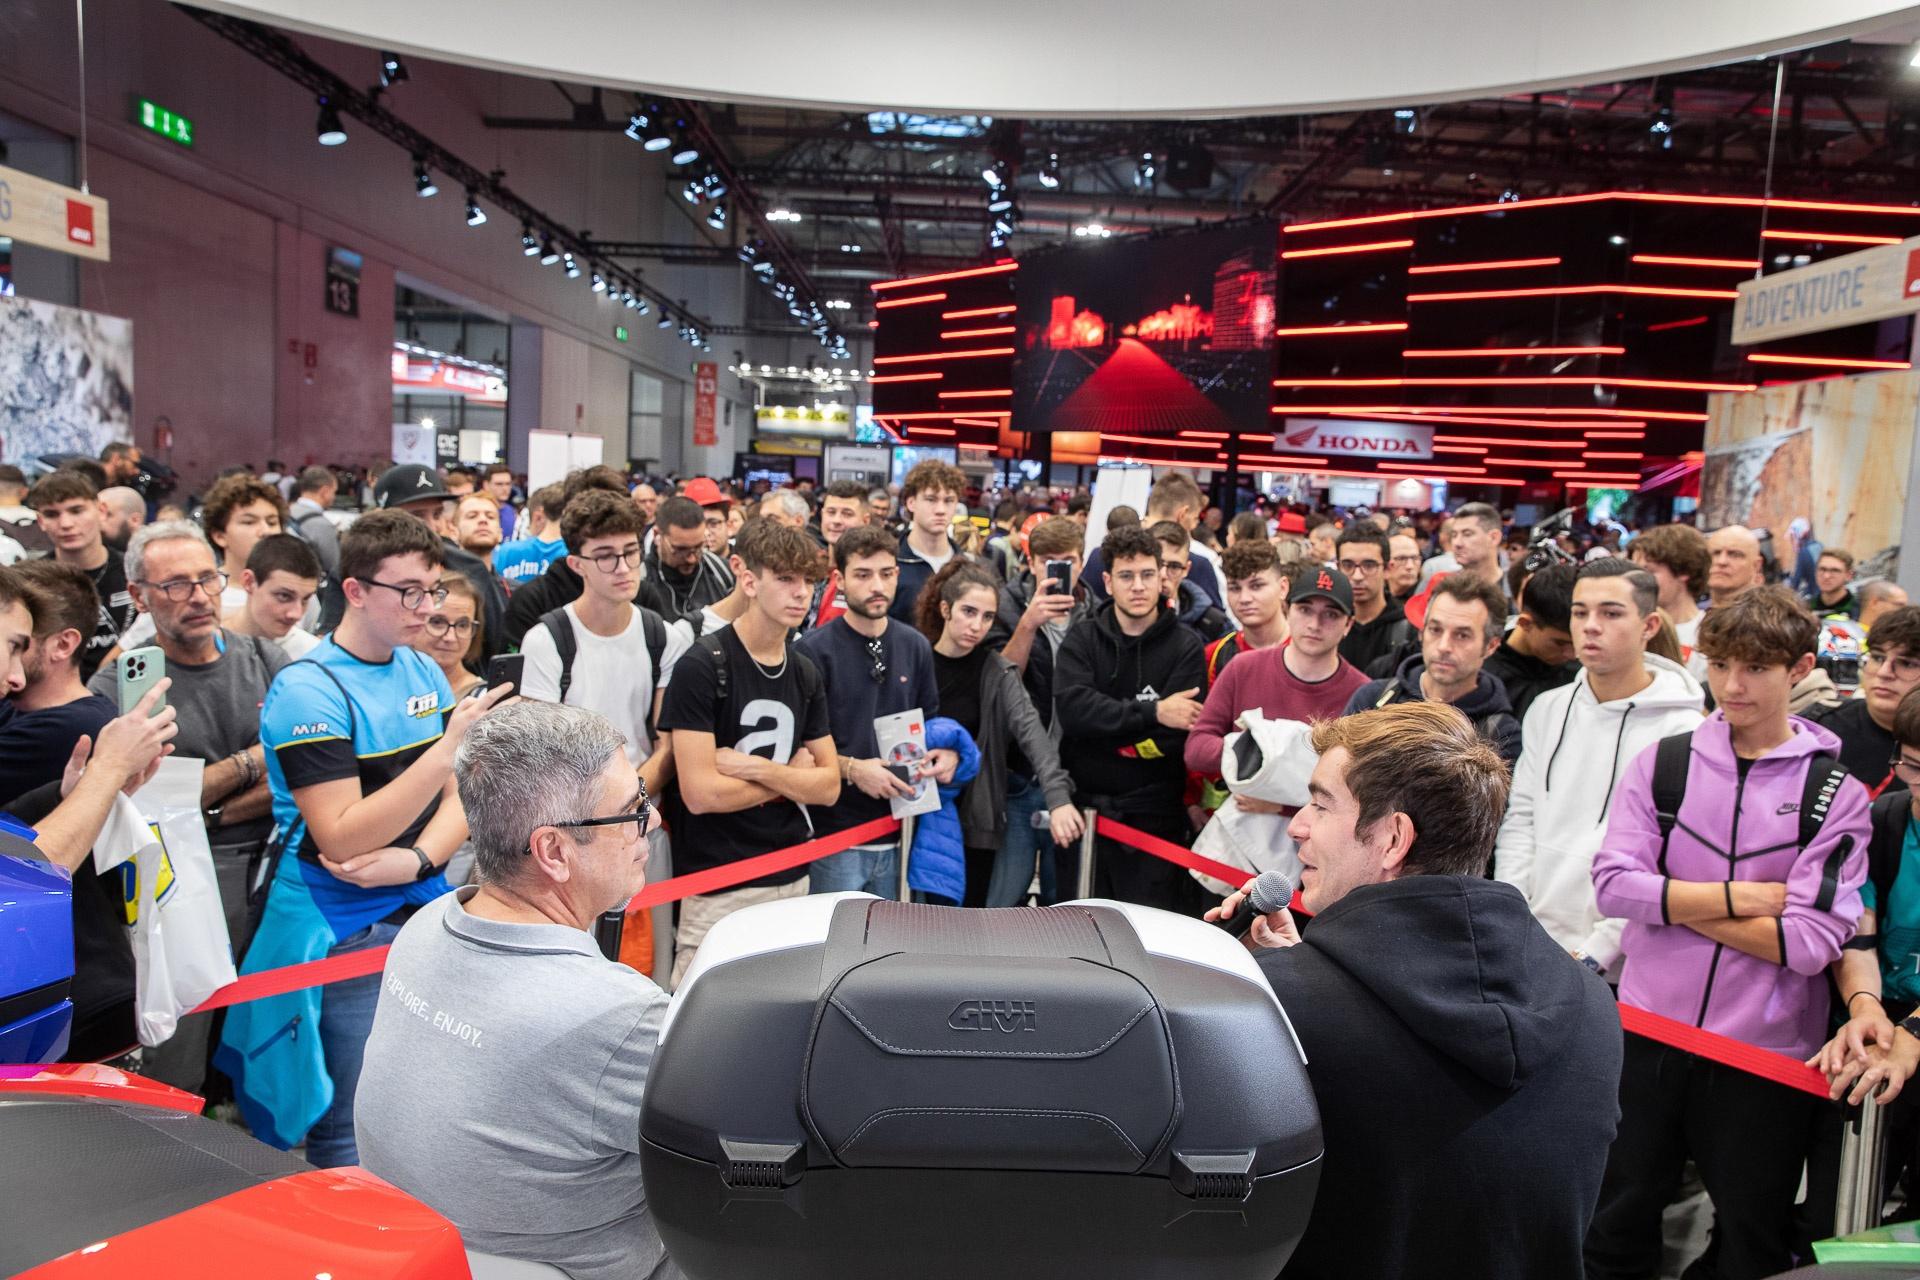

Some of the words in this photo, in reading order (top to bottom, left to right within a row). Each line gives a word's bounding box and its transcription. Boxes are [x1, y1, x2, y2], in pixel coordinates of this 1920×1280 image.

[329, 281, 351, 311] 13
[1742, 265, 1867, 329] ADVENTURE
[1318, 434, 1420, 453] HONDA
[1316, 570, 1334, 591] LA
[734, 698, 795, 765] a
[386, 972, 429, 1022] EXPLORE.
[433, 1010, 482, 1048] ENJOY.
[947, 1000, 1036, 1033] GIVI
